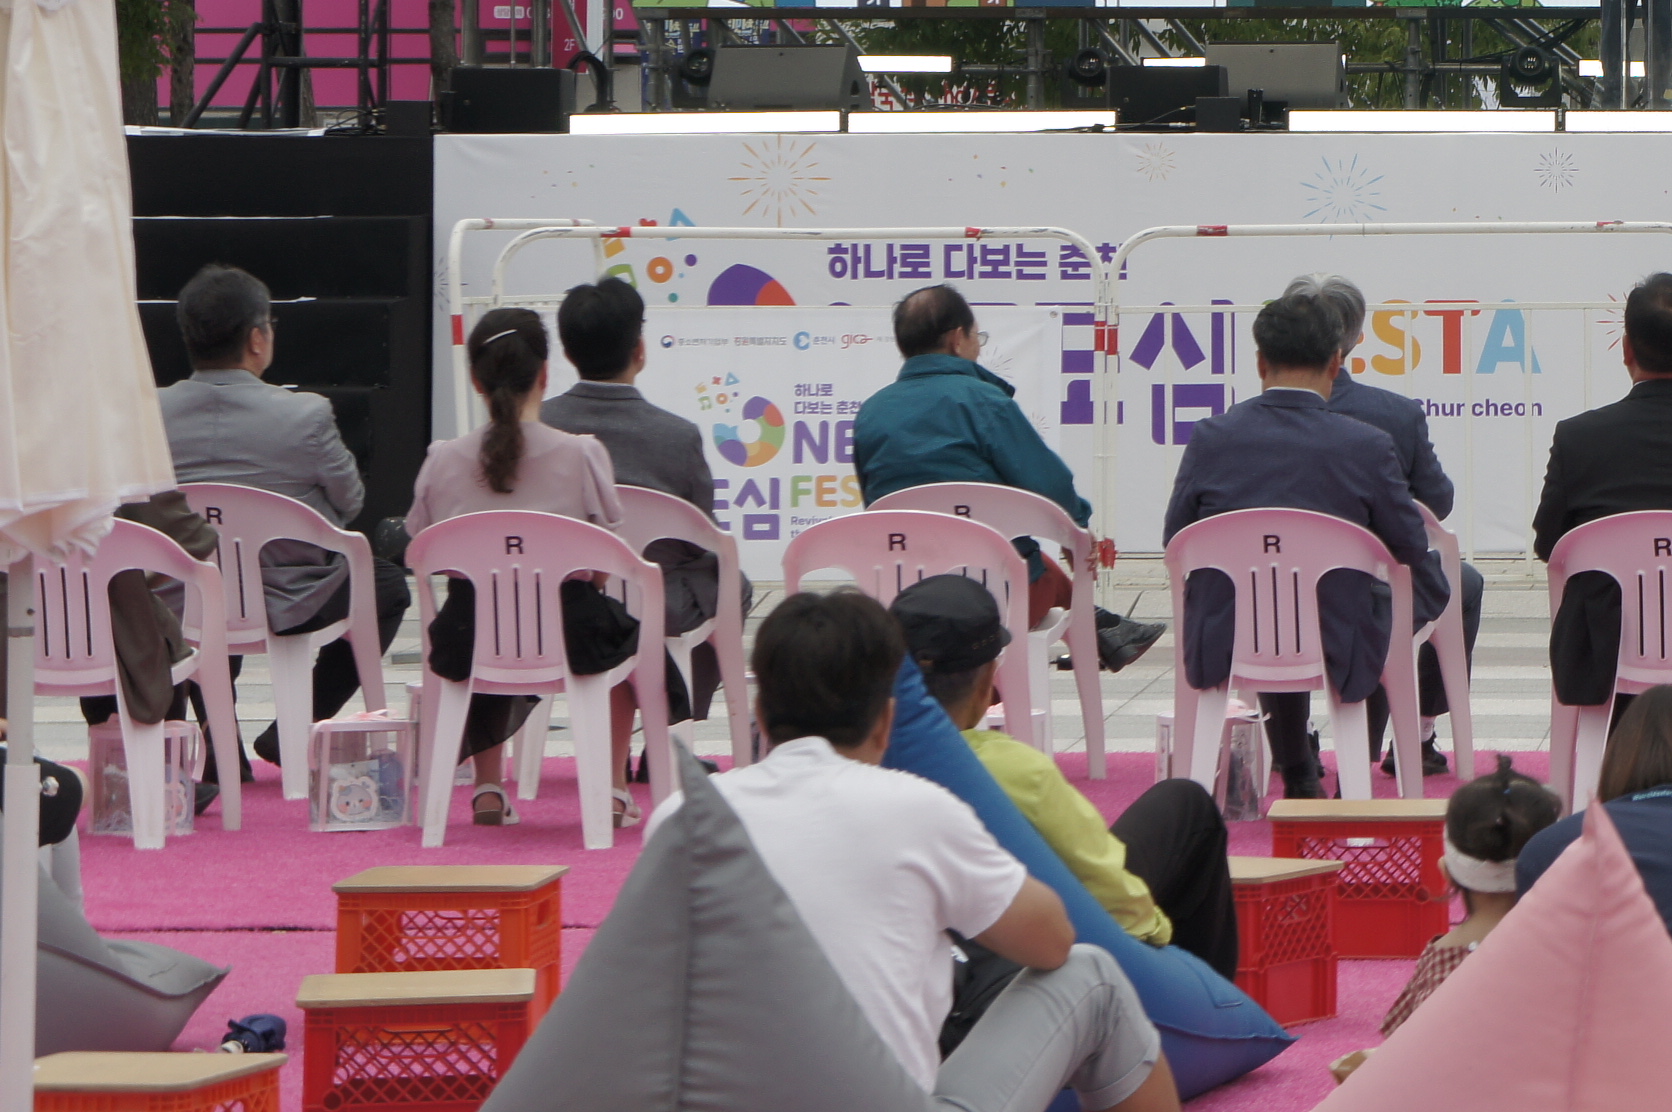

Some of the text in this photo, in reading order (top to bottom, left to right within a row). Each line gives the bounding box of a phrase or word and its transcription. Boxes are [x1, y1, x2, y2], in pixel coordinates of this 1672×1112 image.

[564, 38, 576, 52] 2F
[827, 243, 932, 281] 하나로
[943, 243, 1048, 281] 다보는
[1351, 299, 1542, 376] STA
[794, 383, 833, 397] 하나로
[794, 401, 833, 415] 다보는
[790, 474, 862, 508] FES
[205, 506, 223, 526] R
[504, 535, 524, 555] R
[888, 533, 907, 552] R
[1262, 534, 1281, 554] R
[1653, 537, 1672, 557] R
